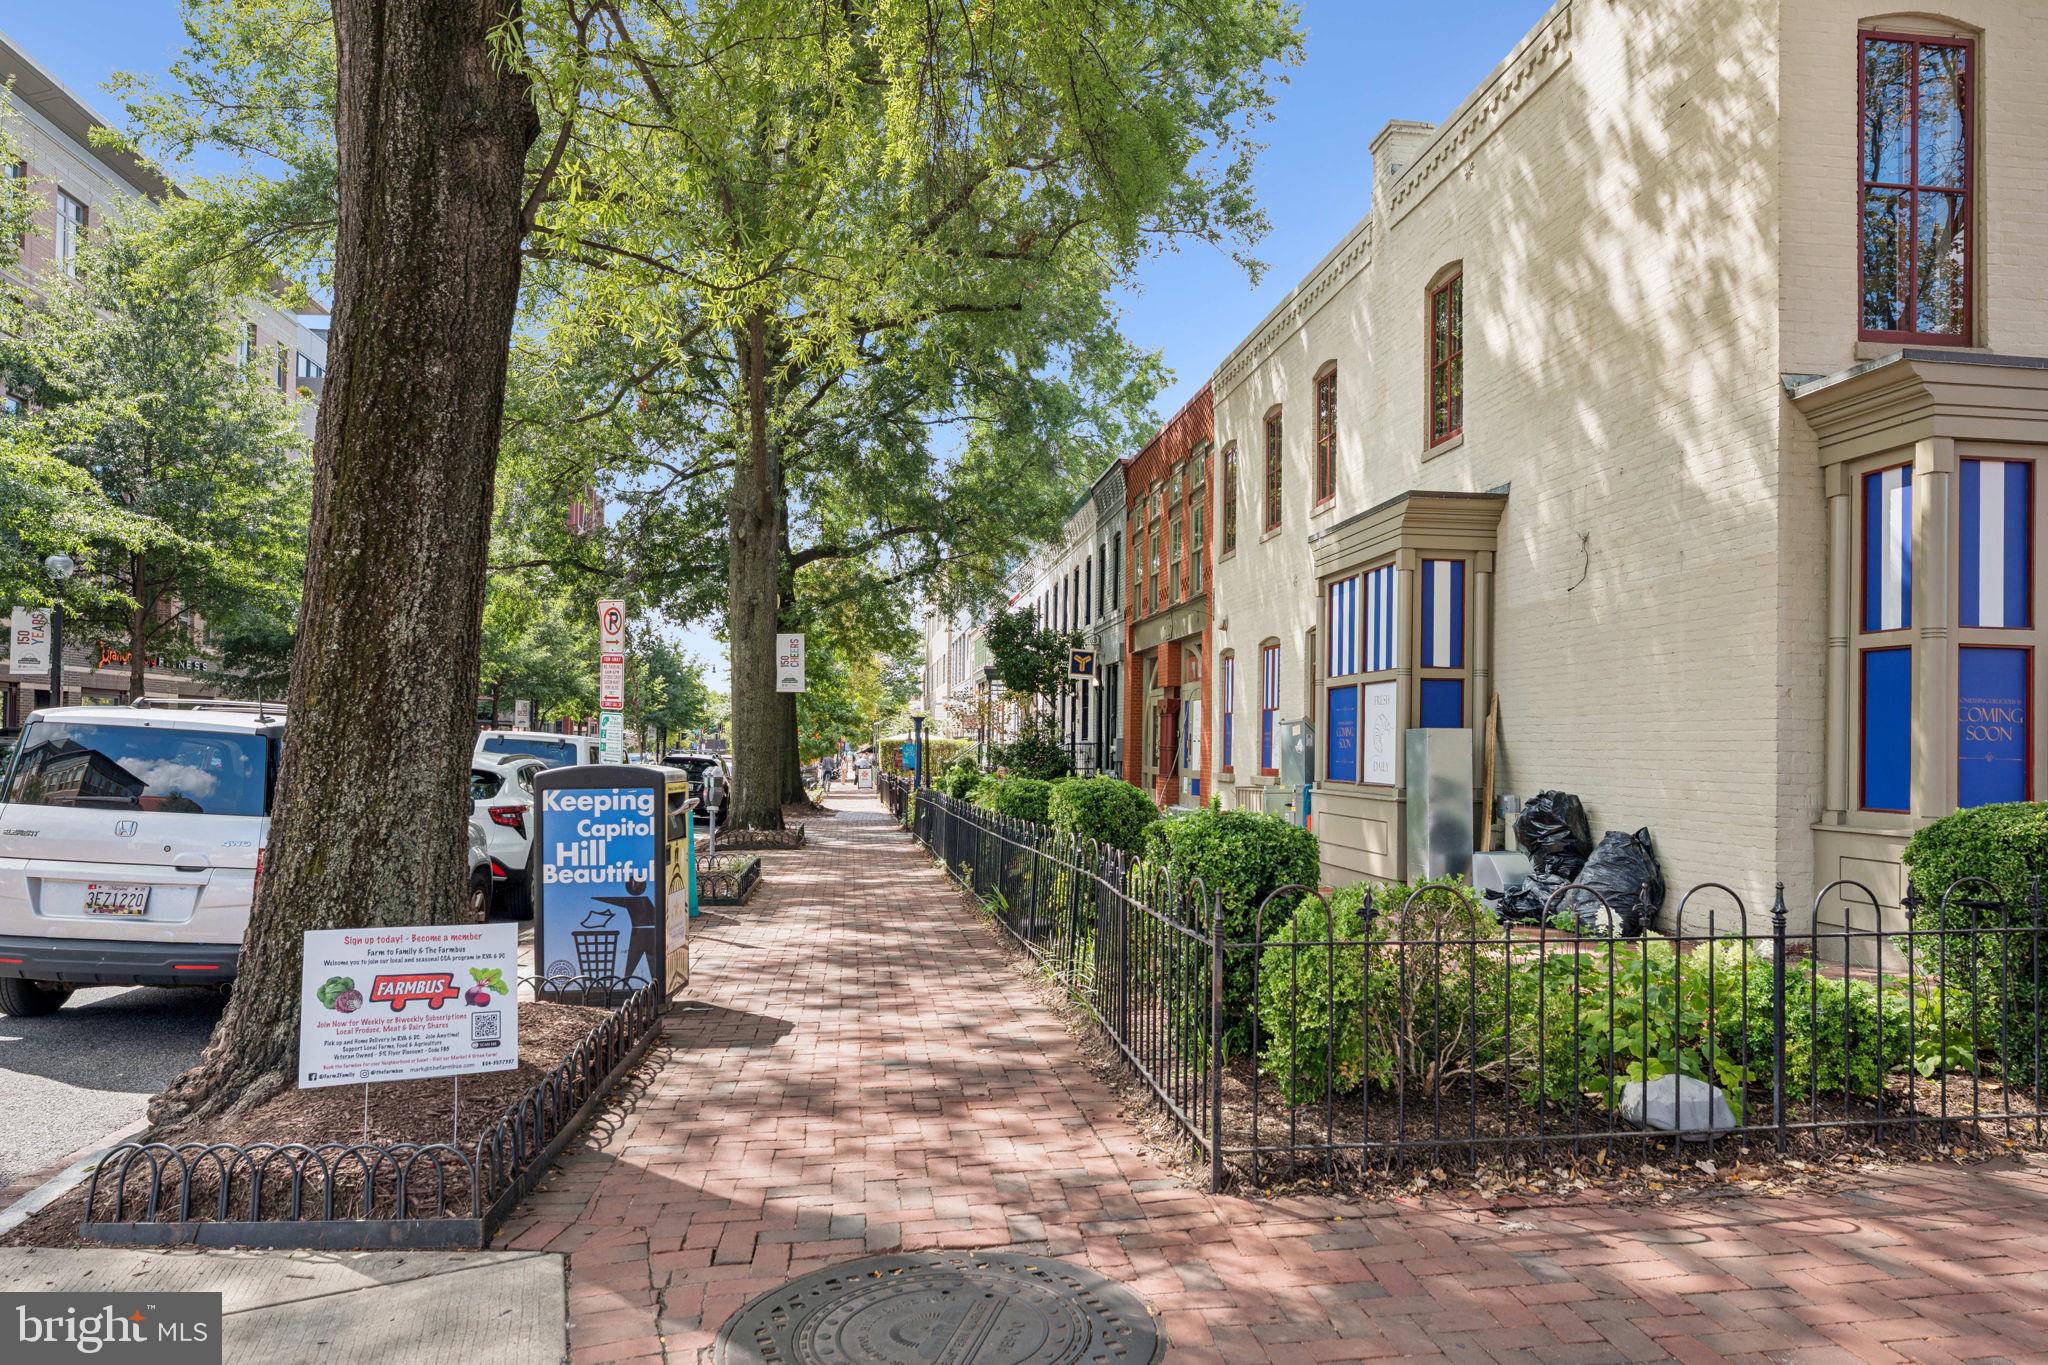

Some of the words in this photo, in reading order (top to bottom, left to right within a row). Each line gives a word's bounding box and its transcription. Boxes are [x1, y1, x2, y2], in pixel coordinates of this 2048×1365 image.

[17, 630, 30, 645] 150
[781, 655, 789, 667] 150
[790, 638, 800, 668] CHEERS
[1959, 707, 2023, 723] COMING
[1966, 726, 2012, 741] SOON
[542, 788, 655, 817] Keeping
[577, 817, 655, 842] Capitol
[557, 840, 606, 866] Hill
[543, 860, 655, 884] Beautiful
[344, 936, 362, 945] Sign
[365, 936, 374, 945] up
[377, 934, 403, 944] today!
[412, 934, 441, 942] Become
[450, 932, 482, 941] member
[377, 980, 445, 996] FARMBUS
[395, 1016, 424, 1024] Biweekly
[425, 1014, 467, 1022] Subscriptions
